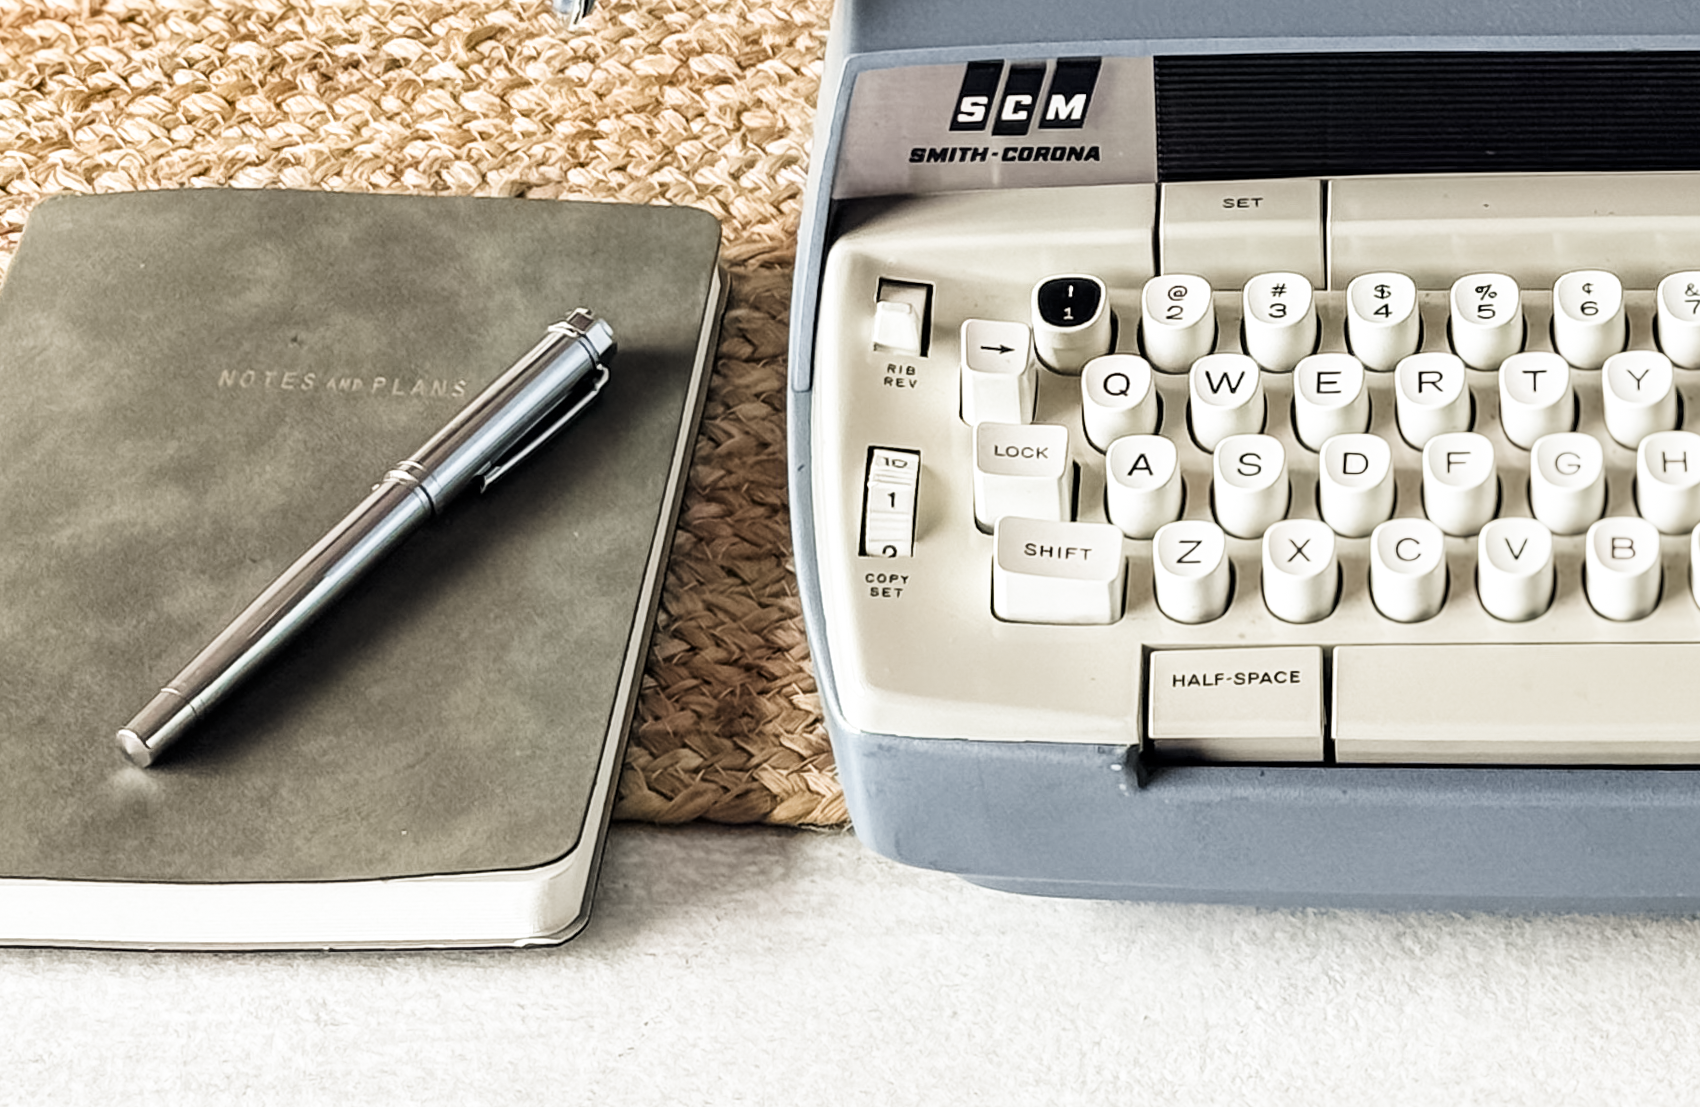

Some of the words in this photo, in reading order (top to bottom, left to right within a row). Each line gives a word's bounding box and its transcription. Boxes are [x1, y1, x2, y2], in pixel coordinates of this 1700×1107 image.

[955, 93, 1087, 124] SCM
[908, 145, 1101, 164] SMITH-CORONA
[1222, 197, 1264, 209] SET
[1167, 285, 1189, 302] @
[1271, 282, 1288, 298] #
[1372, 283, 1393, 300] $
[1474, 283, 1498, 301] %
[1683, 282, 1700, 297] &
[1165, 305, 1185, 320] 2
[1268, 302, 1288, 319] 3
[1373, 303, 1394, 319] 4
[1477, 303, 1496, 320] 5
[1579, 300, 1600, 316] 6
[886, 363, 917, 377] RIB
[1625, 368, 1651, 391] Y
[217, 368, 317, 393] NOTES
[325, 376, 364, 393] AND
[370, 375, 469, 399] PLANS
[883, 376, 918, 389] REV
[1102, 372, 1132, 397] Q
[1204, 370, 1247, 394] W
[1315, 371, 1343, 394] E
[1416, 370, 1444, 394] R
[1521, 369, 1548, 393] T
[993, 444, 1050, 461] LOCK
[1661, 450, 1689, 474] H
[1126, 452, 1155, 477] A
[1236, 452, 1263, 477] S
[1342, 451, 1370, 475] D
[1445, 451, 1472, 475] F
[1553, 451, 1582, 476] G
[887, 491, 897, 509] 1
[1023, 542, 1093, 562] SHIFT
[1176, 539, 1203, 564] Z
[1286, 538, 1312, 563] X
[1394, 537, 1423, 563] C
[1503, 537, 1529, 562] V
[1610, 536, 1637, 561] B
[864, 572, 910, 585] COPY
[869, 586, 904, 599] SET
[1171, 669, 1302, 688] HALF-SPACE
